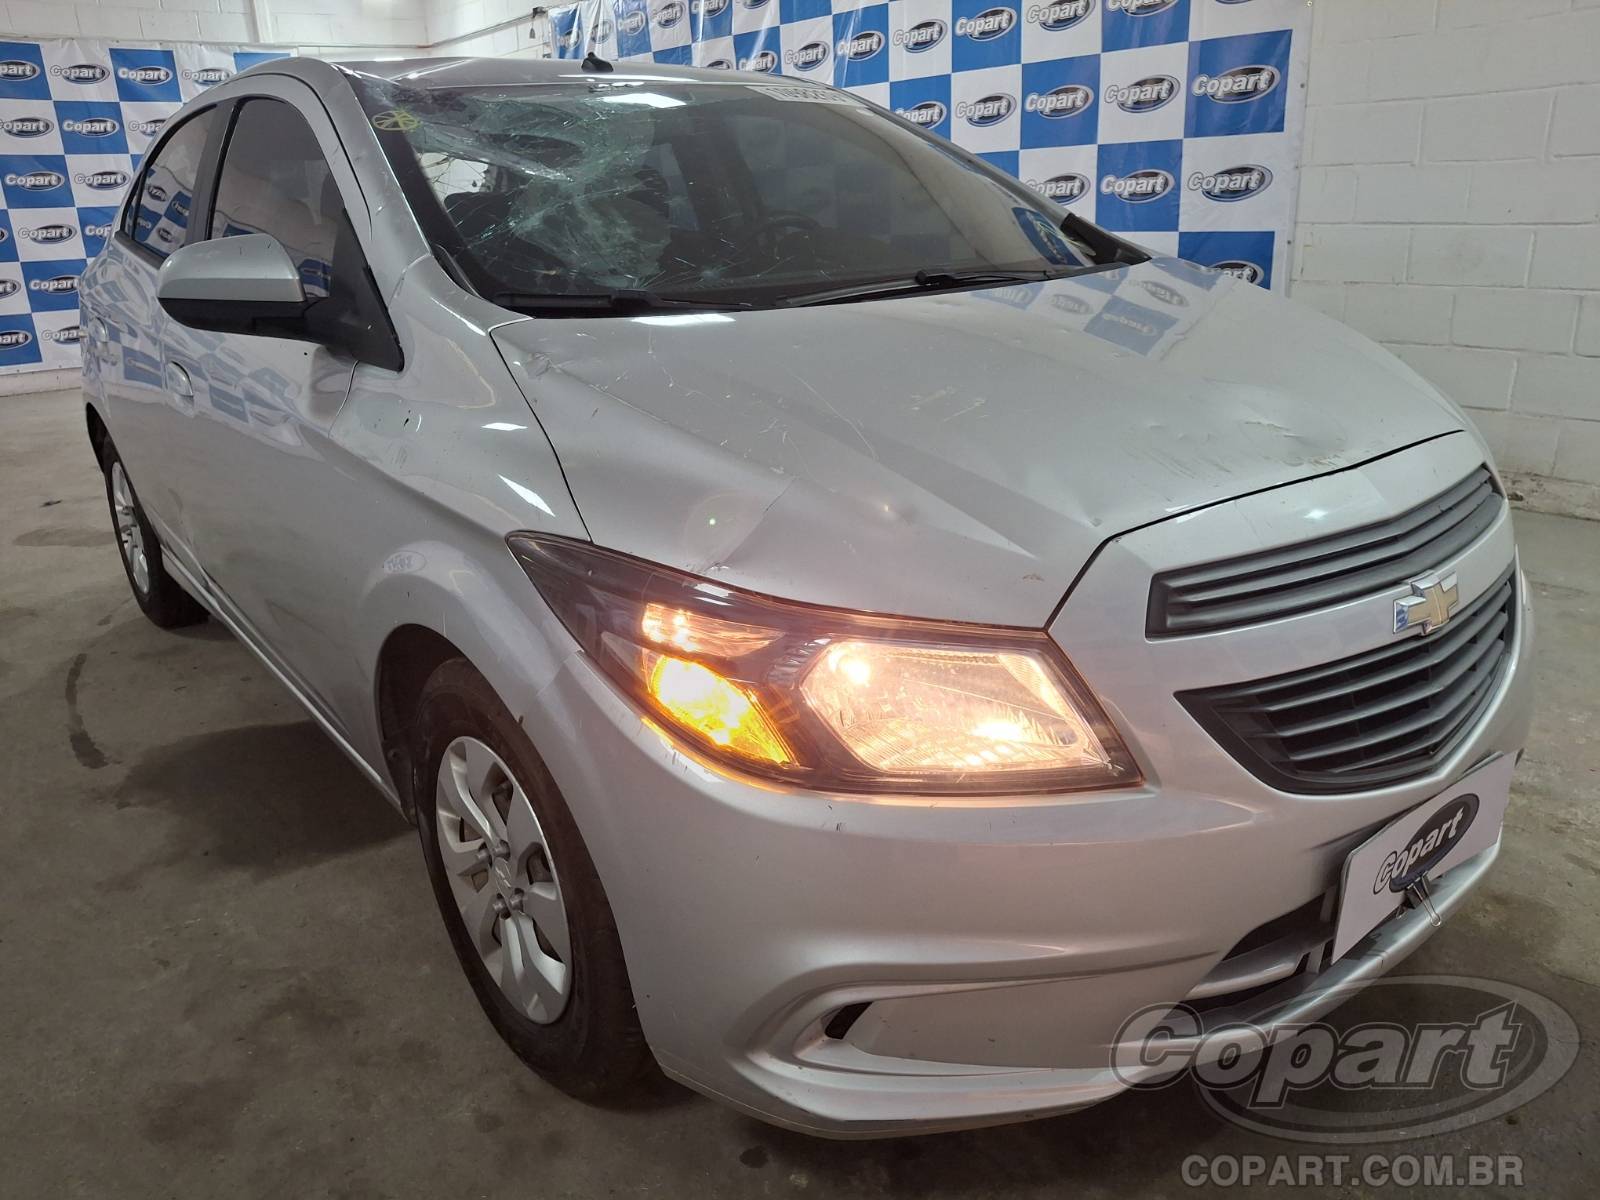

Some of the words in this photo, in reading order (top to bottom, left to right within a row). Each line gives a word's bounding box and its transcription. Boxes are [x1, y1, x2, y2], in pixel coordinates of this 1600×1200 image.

[1026, 0, 1087, 26] Copart
[955, 11, 1010, 38] Copart
[838, 34, 879, 56] Copart
[893, 25, 941, 47] Copart
[785, 45, 823, 65] Copart
[50, 65, 102, 80] Copart
[118, 67, 167, 81] Copart
[182, 69, 226, 81] Copart
[1104, 80, 1171, 106] Copart
[1192, 70, 1272, 98] Copart
[956, 97, 1009, 121] Copart
[1025, 88, 1086, 114] Copart
[63, 119, 113, 133] Copart
[128, 121, 161, 133] Copa
[5, 174, 58, 188] Copart
[74, 173, 123, 187] Copart
[1101, 173, 1166, 198] Copart
[1188, 169, 1262, 195] Copart
[18, 226, 70, 239] Copart
[42, 329, 78, 341] Copa
[1373, 806, 1464, 894] Copart
